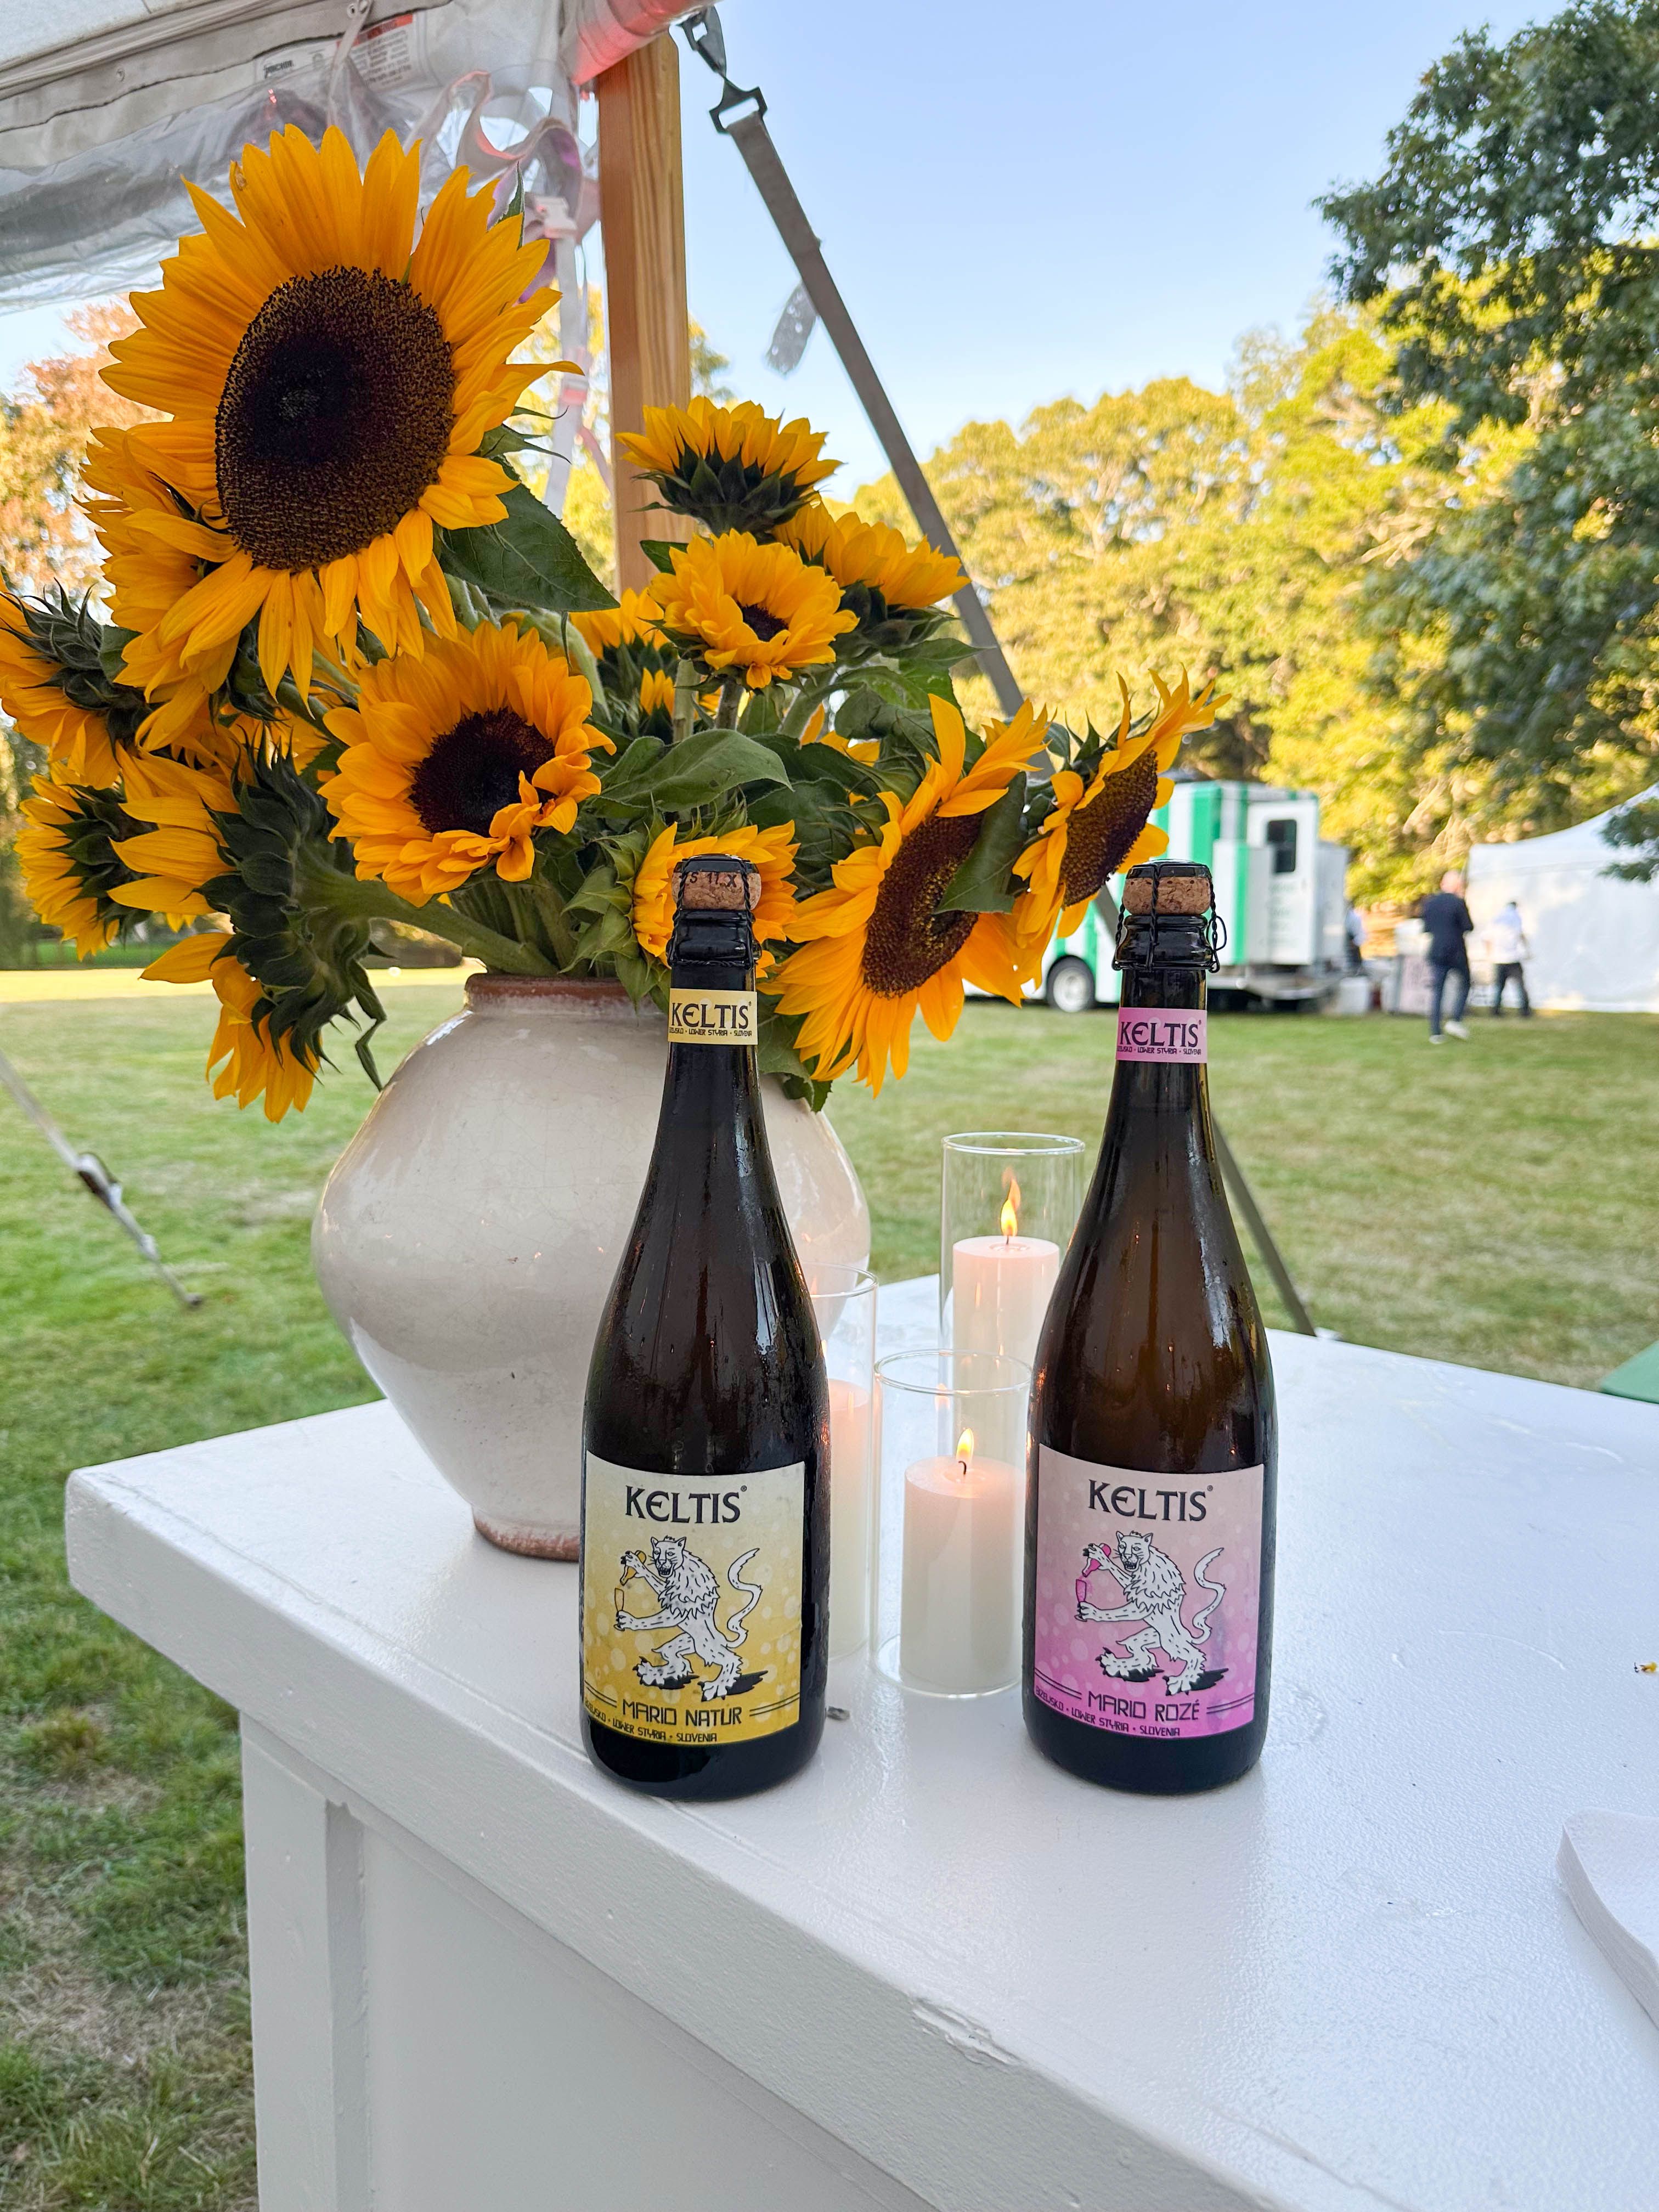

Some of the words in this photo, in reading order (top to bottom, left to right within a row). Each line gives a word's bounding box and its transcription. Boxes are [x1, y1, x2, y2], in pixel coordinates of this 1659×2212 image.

[623, 1699, 677, 1725] MARIO
[686, 1706, 742, 1727] NATUR
[1088, 1690, 1146, 1719] MARIO
[1155, 1699, 1200, 1722] ROZÉ
[613, 1718, 634, 1734] LOWER
[637, 1727, 666, 1741] STYRIA
[676, 1733, 717, 1742] SLOVENIA
[1071, 1707, 1096, 1724] LOWER
[1099, 1718, 1129, 1732] STYRIA
[1139, 1725, 1180, 1736] SLOVENIA
